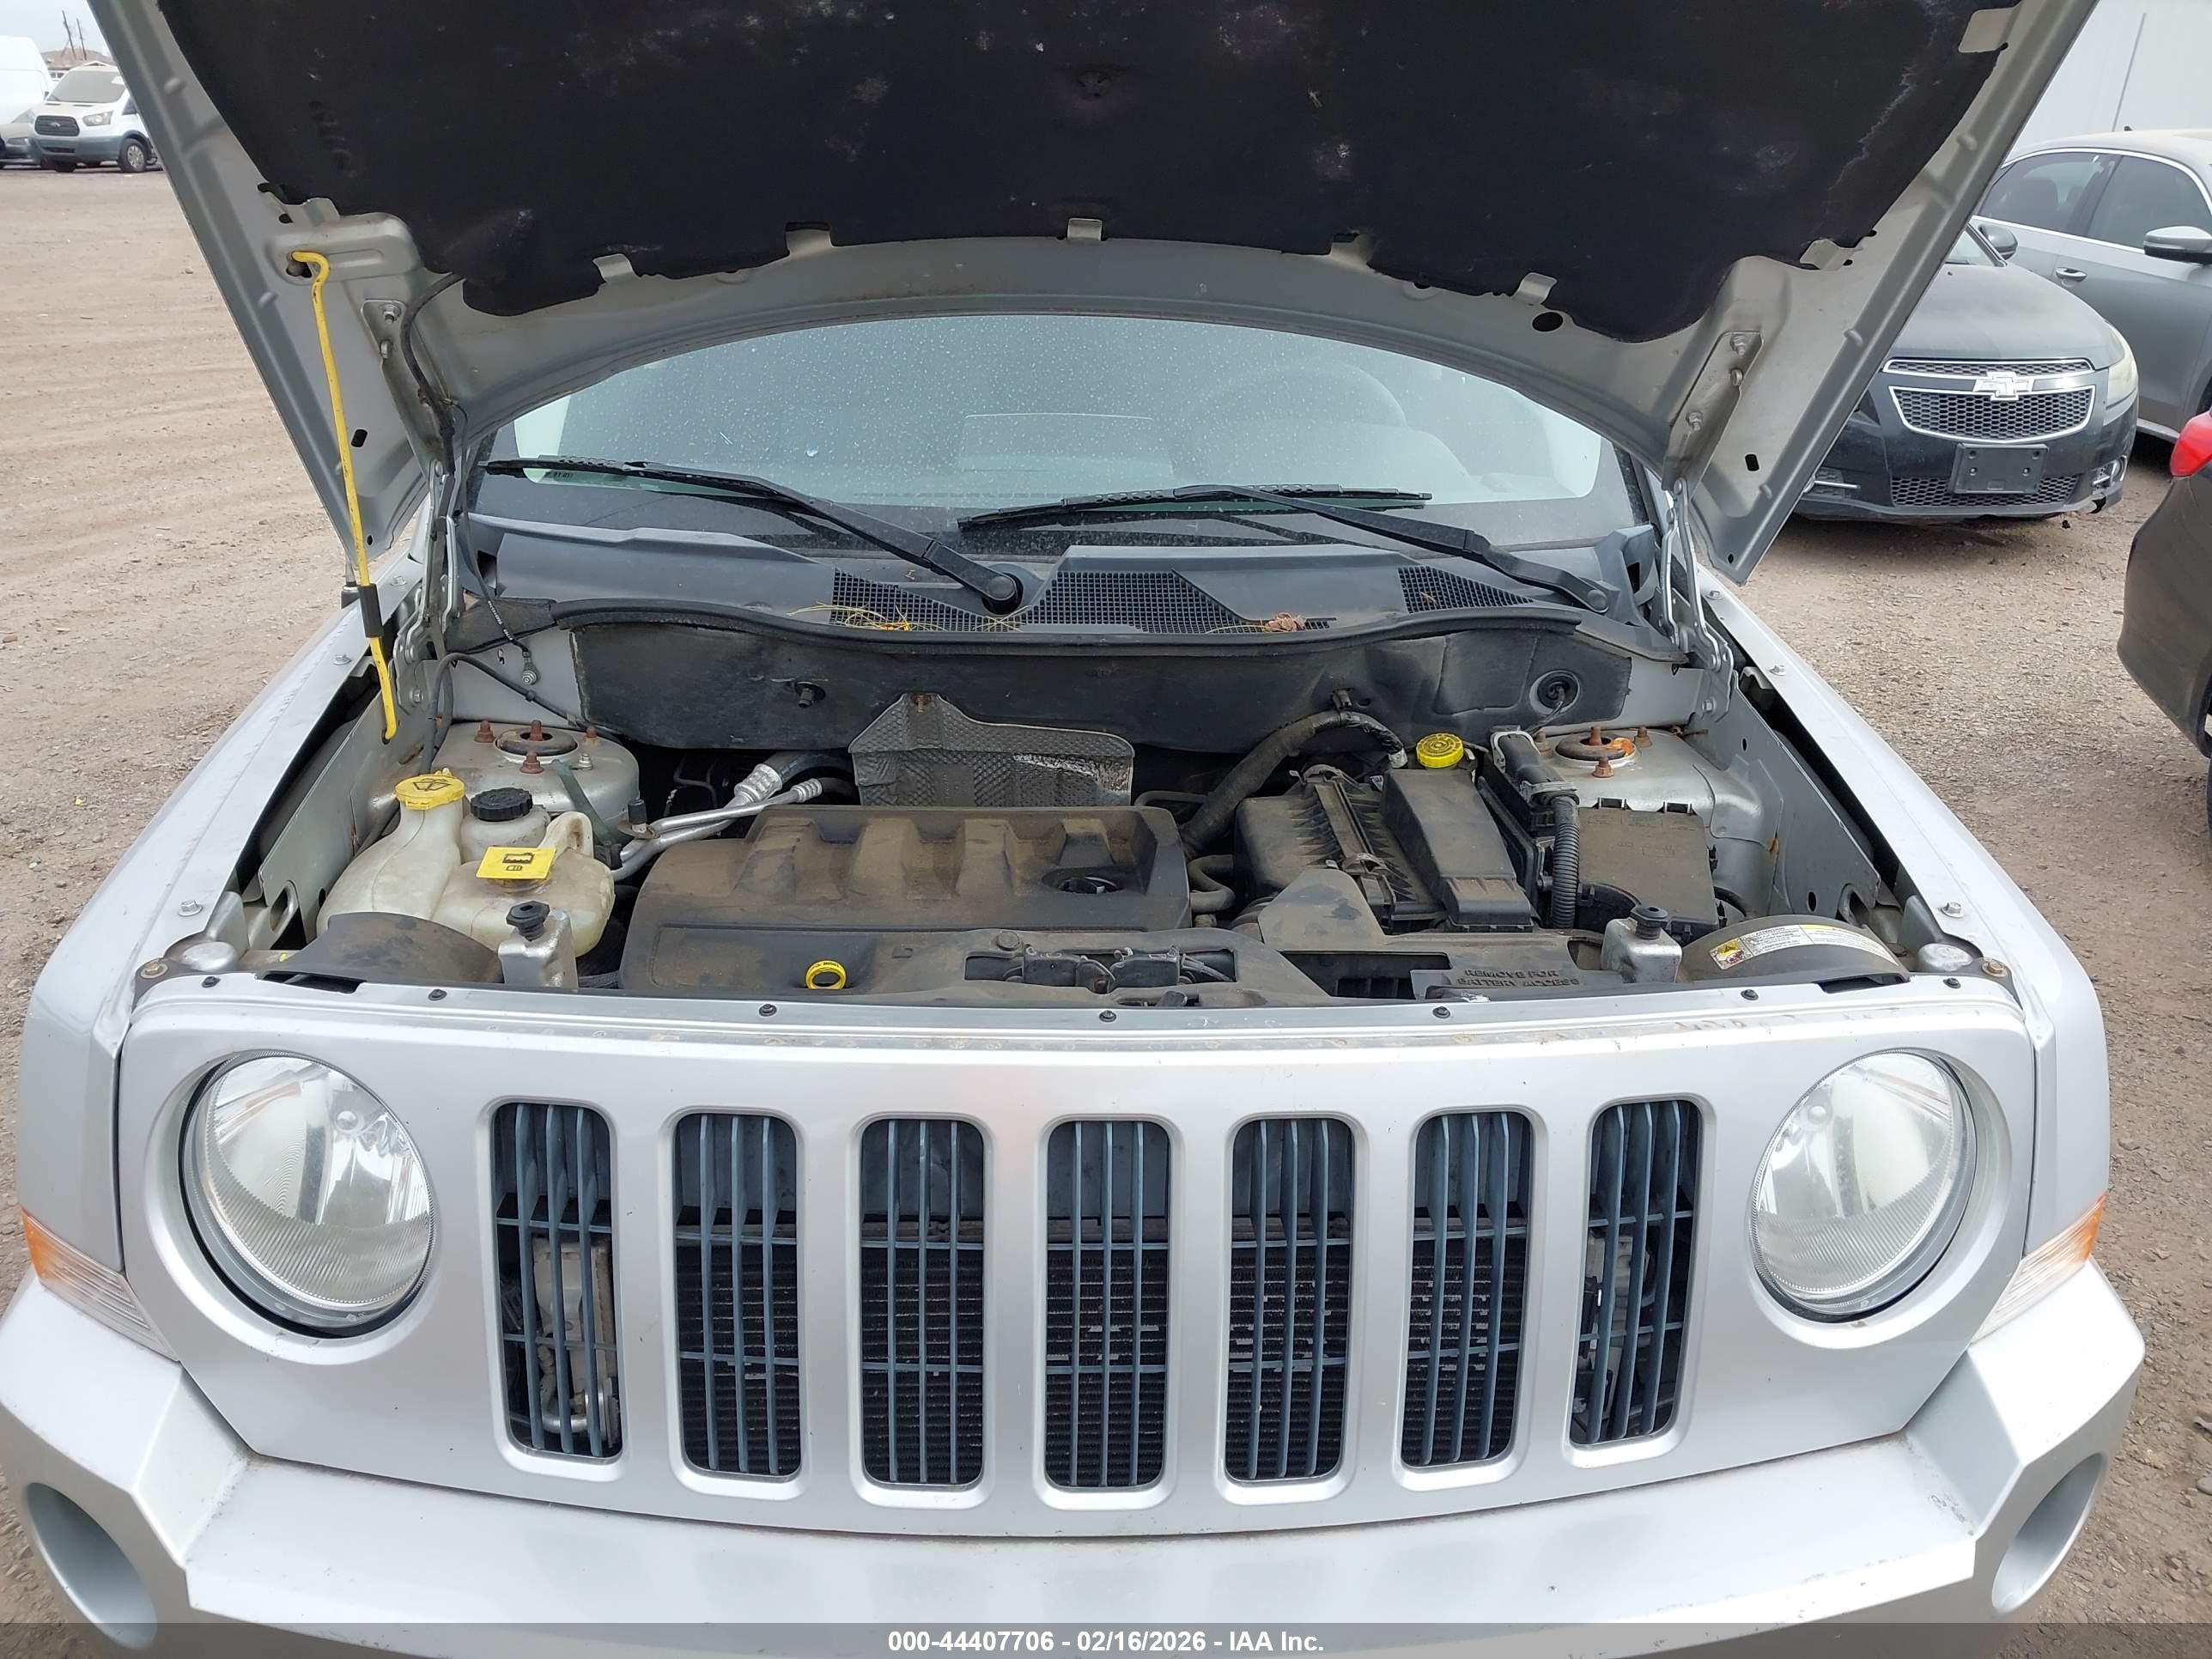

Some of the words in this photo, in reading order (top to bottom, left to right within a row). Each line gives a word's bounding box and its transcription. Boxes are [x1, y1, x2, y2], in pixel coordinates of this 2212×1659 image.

[1463, 969, 1526, 979] REMOVE
[1528, 969, 1559, 979] FOR
[1456, 978, 1516, 988] BATTERY
[1522, 978, 1580, 988] ACCESS
